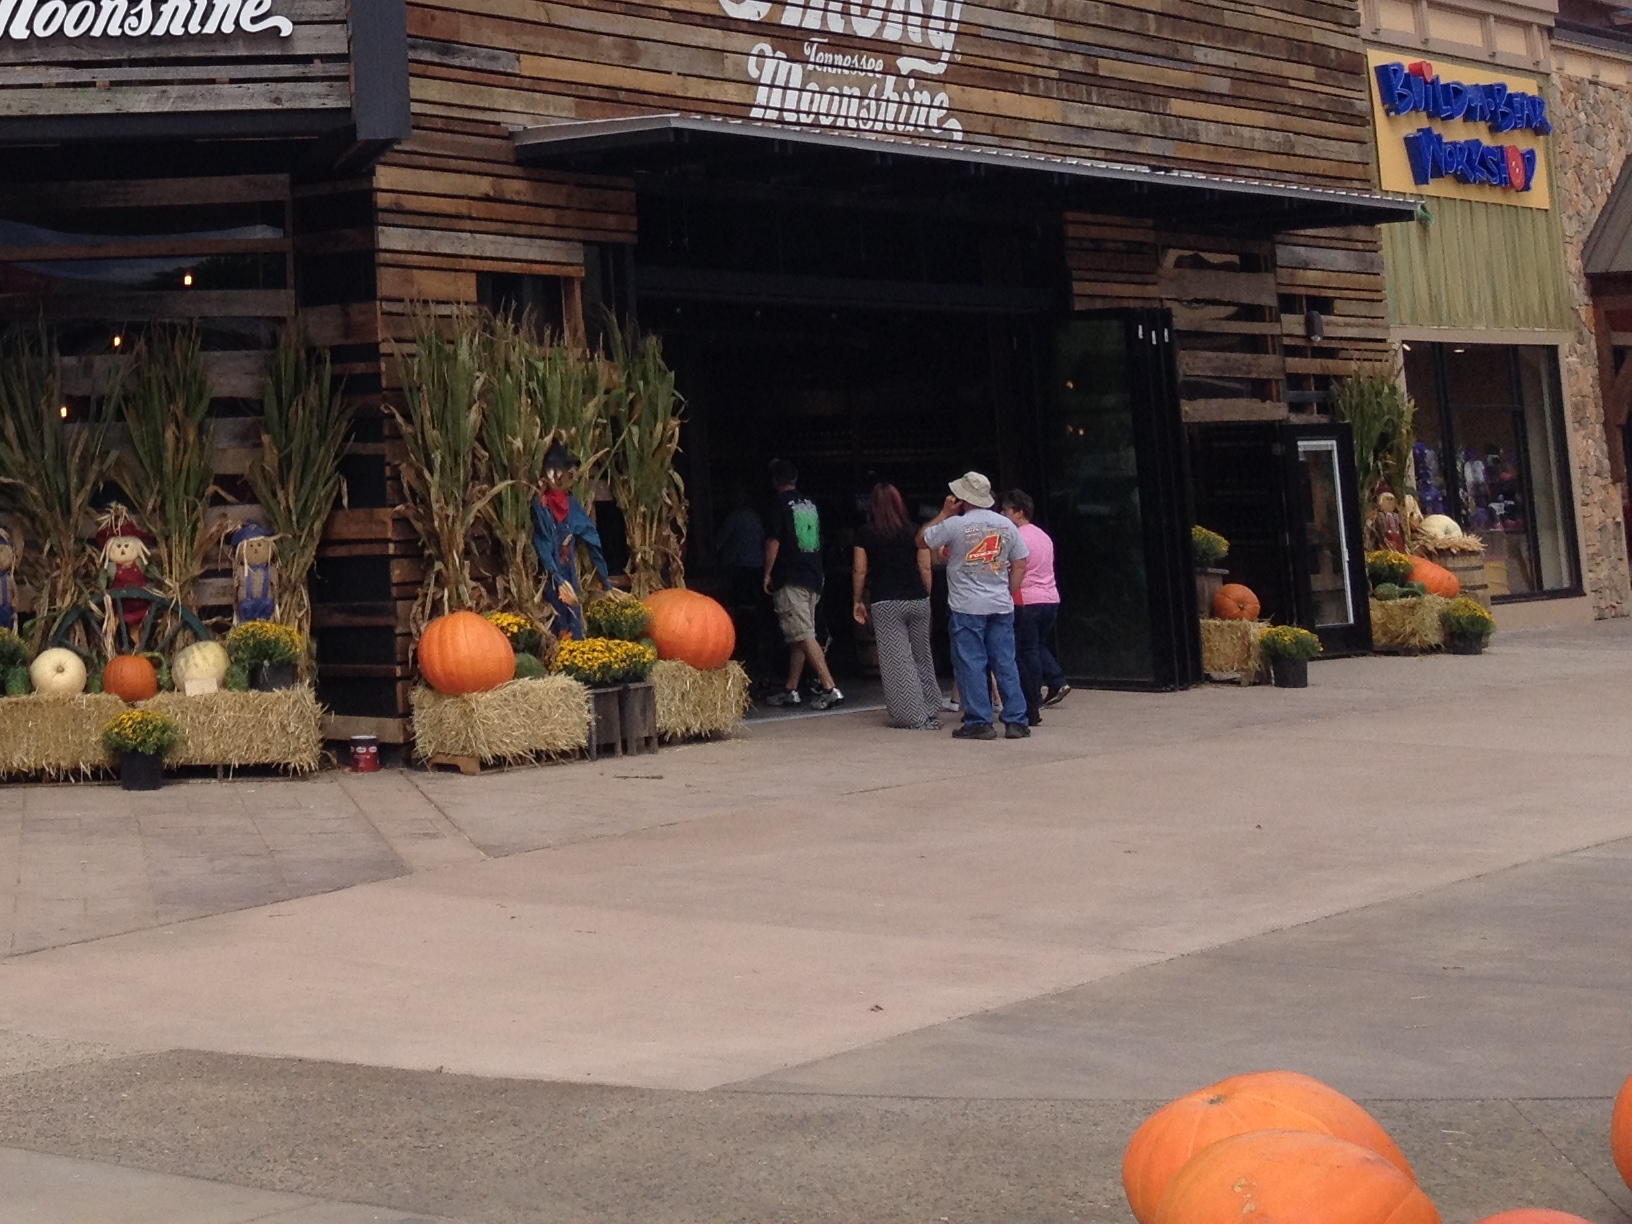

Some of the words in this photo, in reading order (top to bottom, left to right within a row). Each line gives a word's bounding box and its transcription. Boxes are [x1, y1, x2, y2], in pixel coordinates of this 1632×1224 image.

[803, 38, 884, 77] Tennessee
[747, 43, 963, 141] Moonshine
[966, 534, 1001, 564] 4
